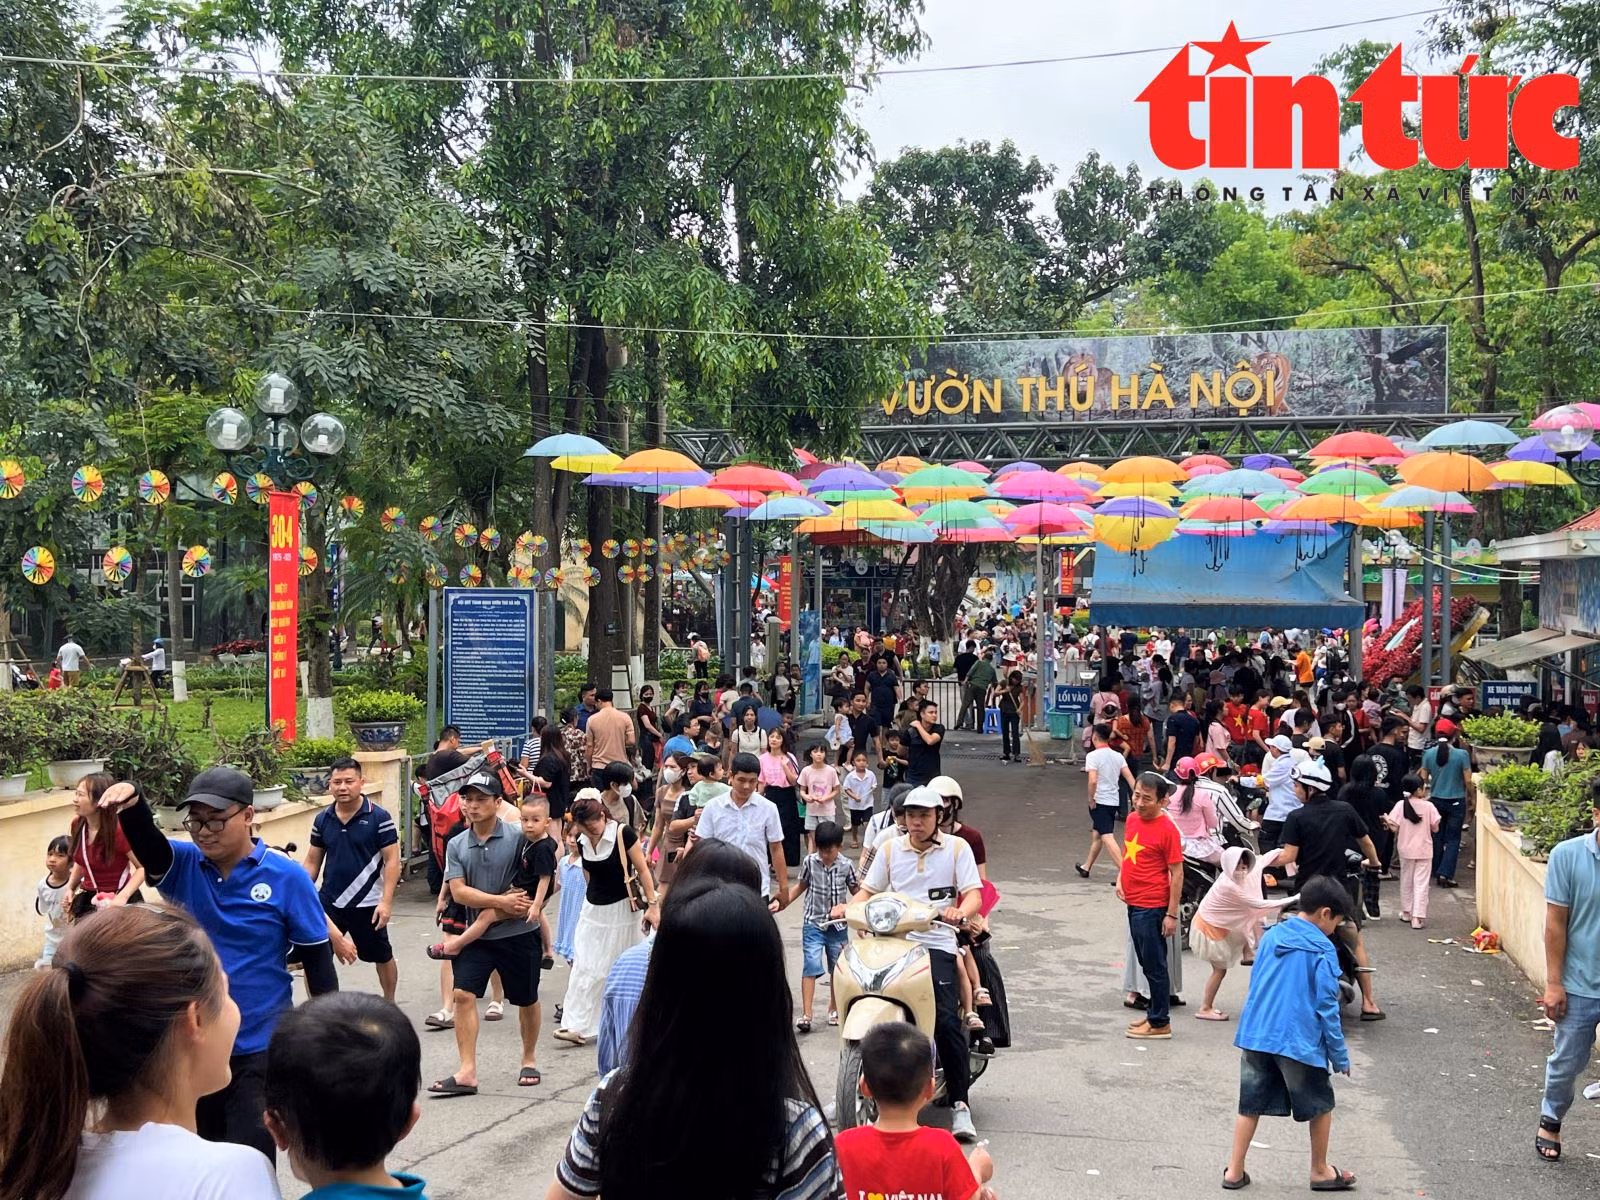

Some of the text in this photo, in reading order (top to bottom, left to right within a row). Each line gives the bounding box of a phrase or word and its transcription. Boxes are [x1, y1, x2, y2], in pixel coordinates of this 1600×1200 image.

[1017, 363, 1096, 412] THÚ
[1111, 361, 1176, 410] HÀ
[1190, 359, 1275, 416] NỘI
[1058, 689, 1088, 703] LỐI VÀO
